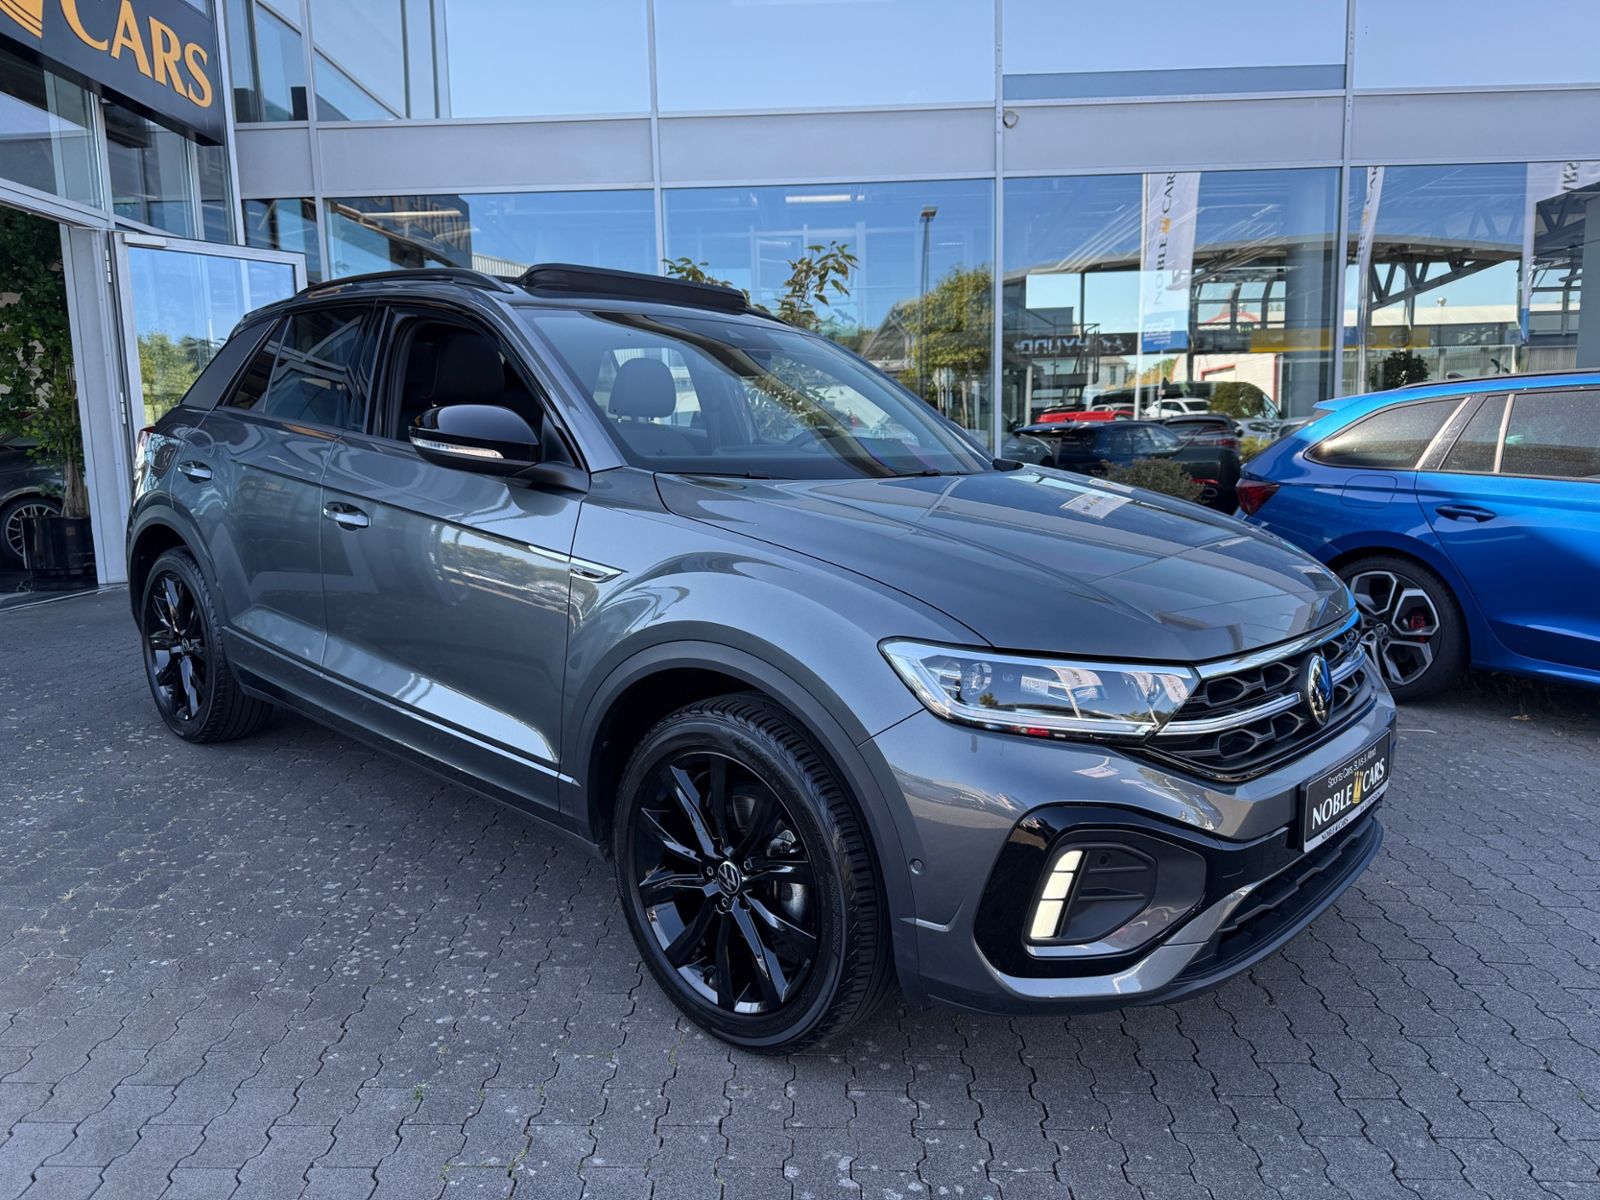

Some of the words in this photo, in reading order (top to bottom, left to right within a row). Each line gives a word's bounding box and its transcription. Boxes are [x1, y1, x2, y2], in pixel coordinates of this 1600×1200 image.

[60, 0, 213, 108] CARS
[1153, 237, 1169, 305] NOBLE
[1312, 783, 1353, 830] NOBLE
[1362, 757, 1385, 791] CARS
[1328, 772, 1343, 788] Sports
